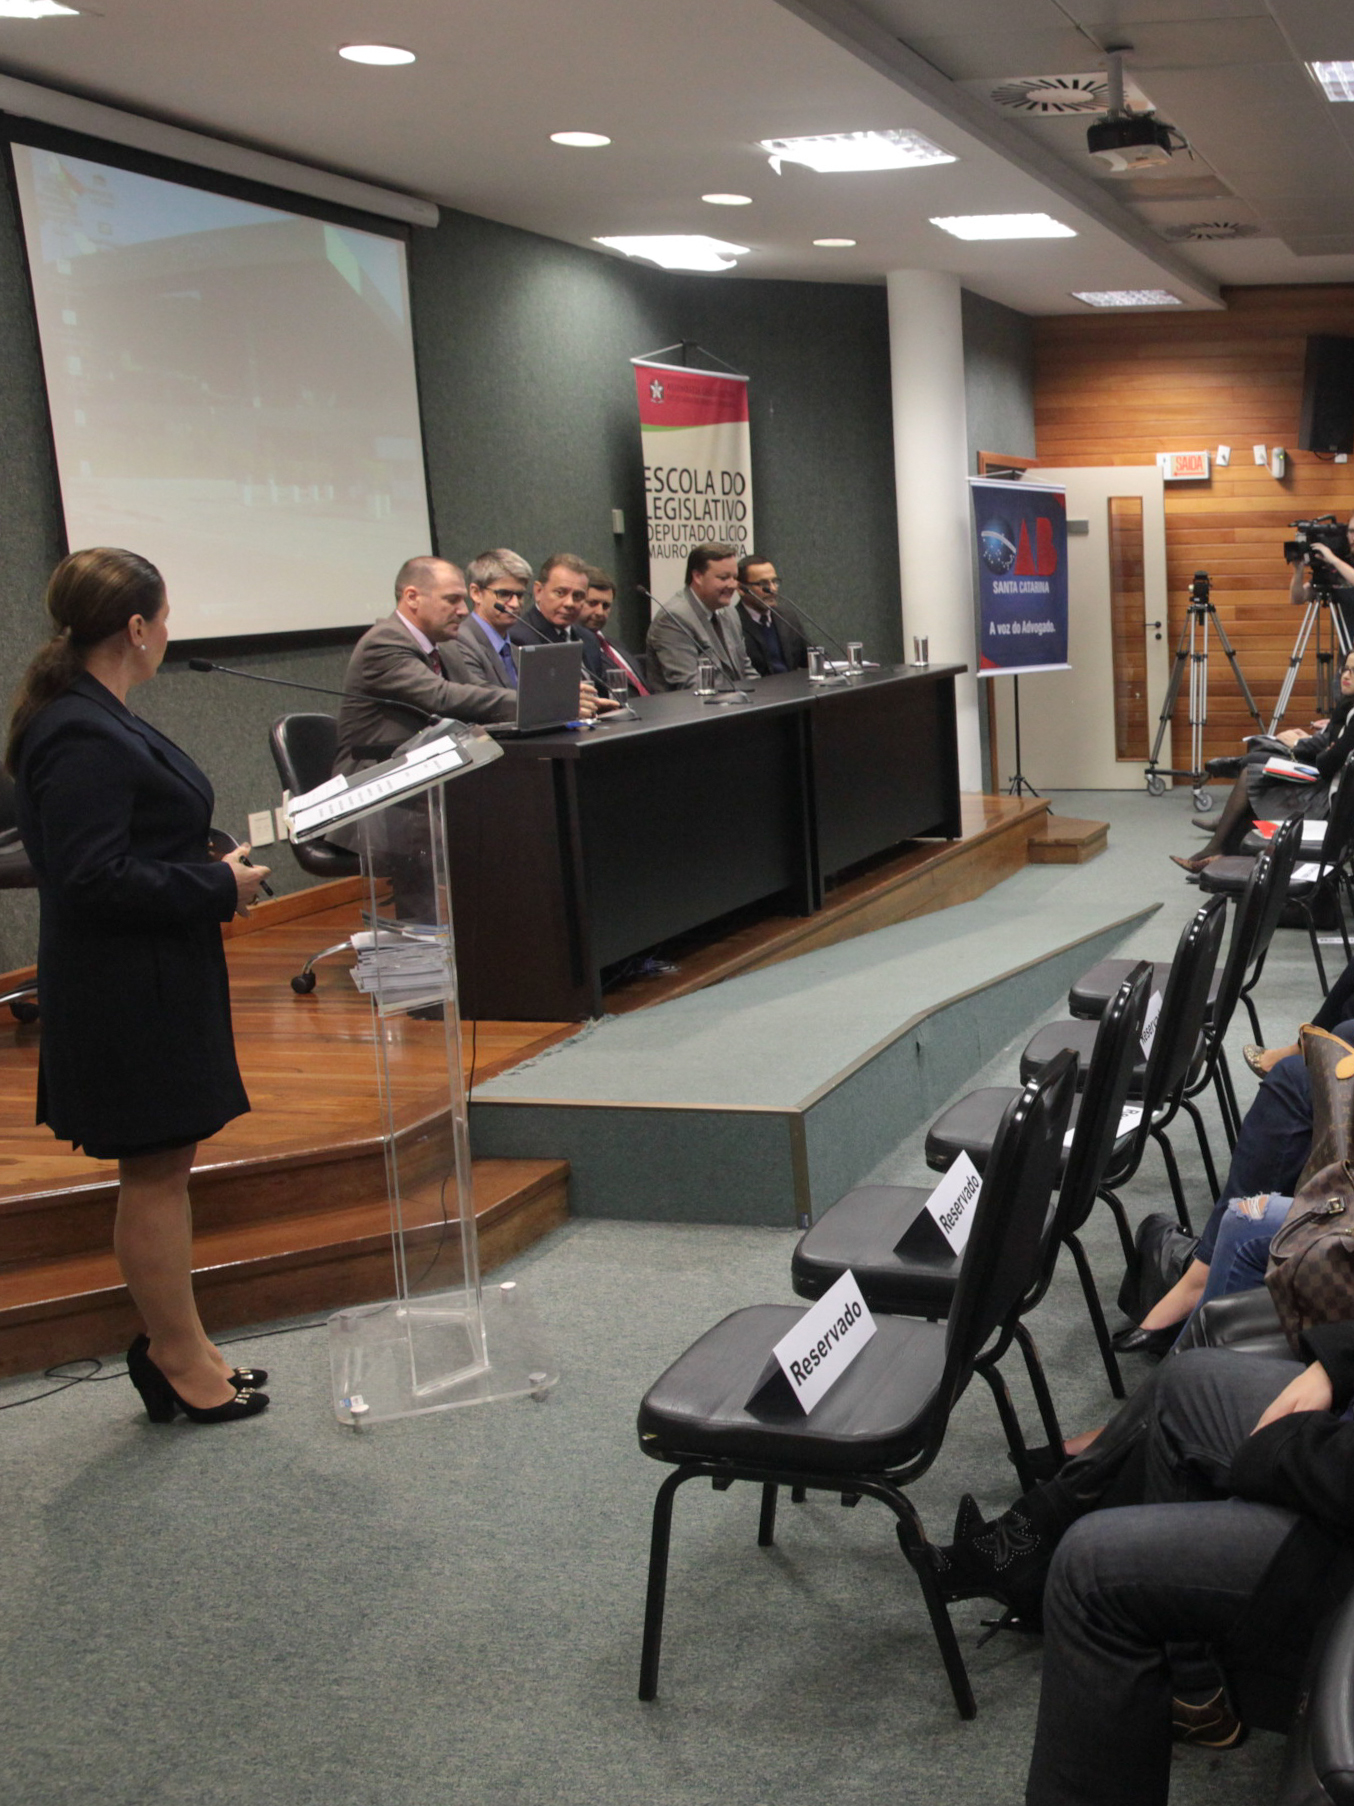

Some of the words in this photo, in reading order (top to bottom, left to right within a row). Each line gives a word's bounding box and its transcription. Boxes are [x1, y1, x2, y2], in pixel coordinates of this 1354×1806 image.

[644, 466, 716, 495] ESCOLA
[721, 470, 746, 496] DO
[648, 524, 716, 541] DEPUTADO
[719, 521, 747, 541] LÍCIO
[649, 544, 688, 559] MAURO
[992, 580, 1018, 595] SANTA
[1019, 581, 1050, 594] CATARINA
[989, 621, 996, 635] A
[997, 623, 1011, 635] voz
[1011, 620, 1022, 635] do
[1021, 619, 1056, 636] Advogado.
[938, 1173, 980, 1234] Reservado
[789, 1299, 862, 1387] Reservado
